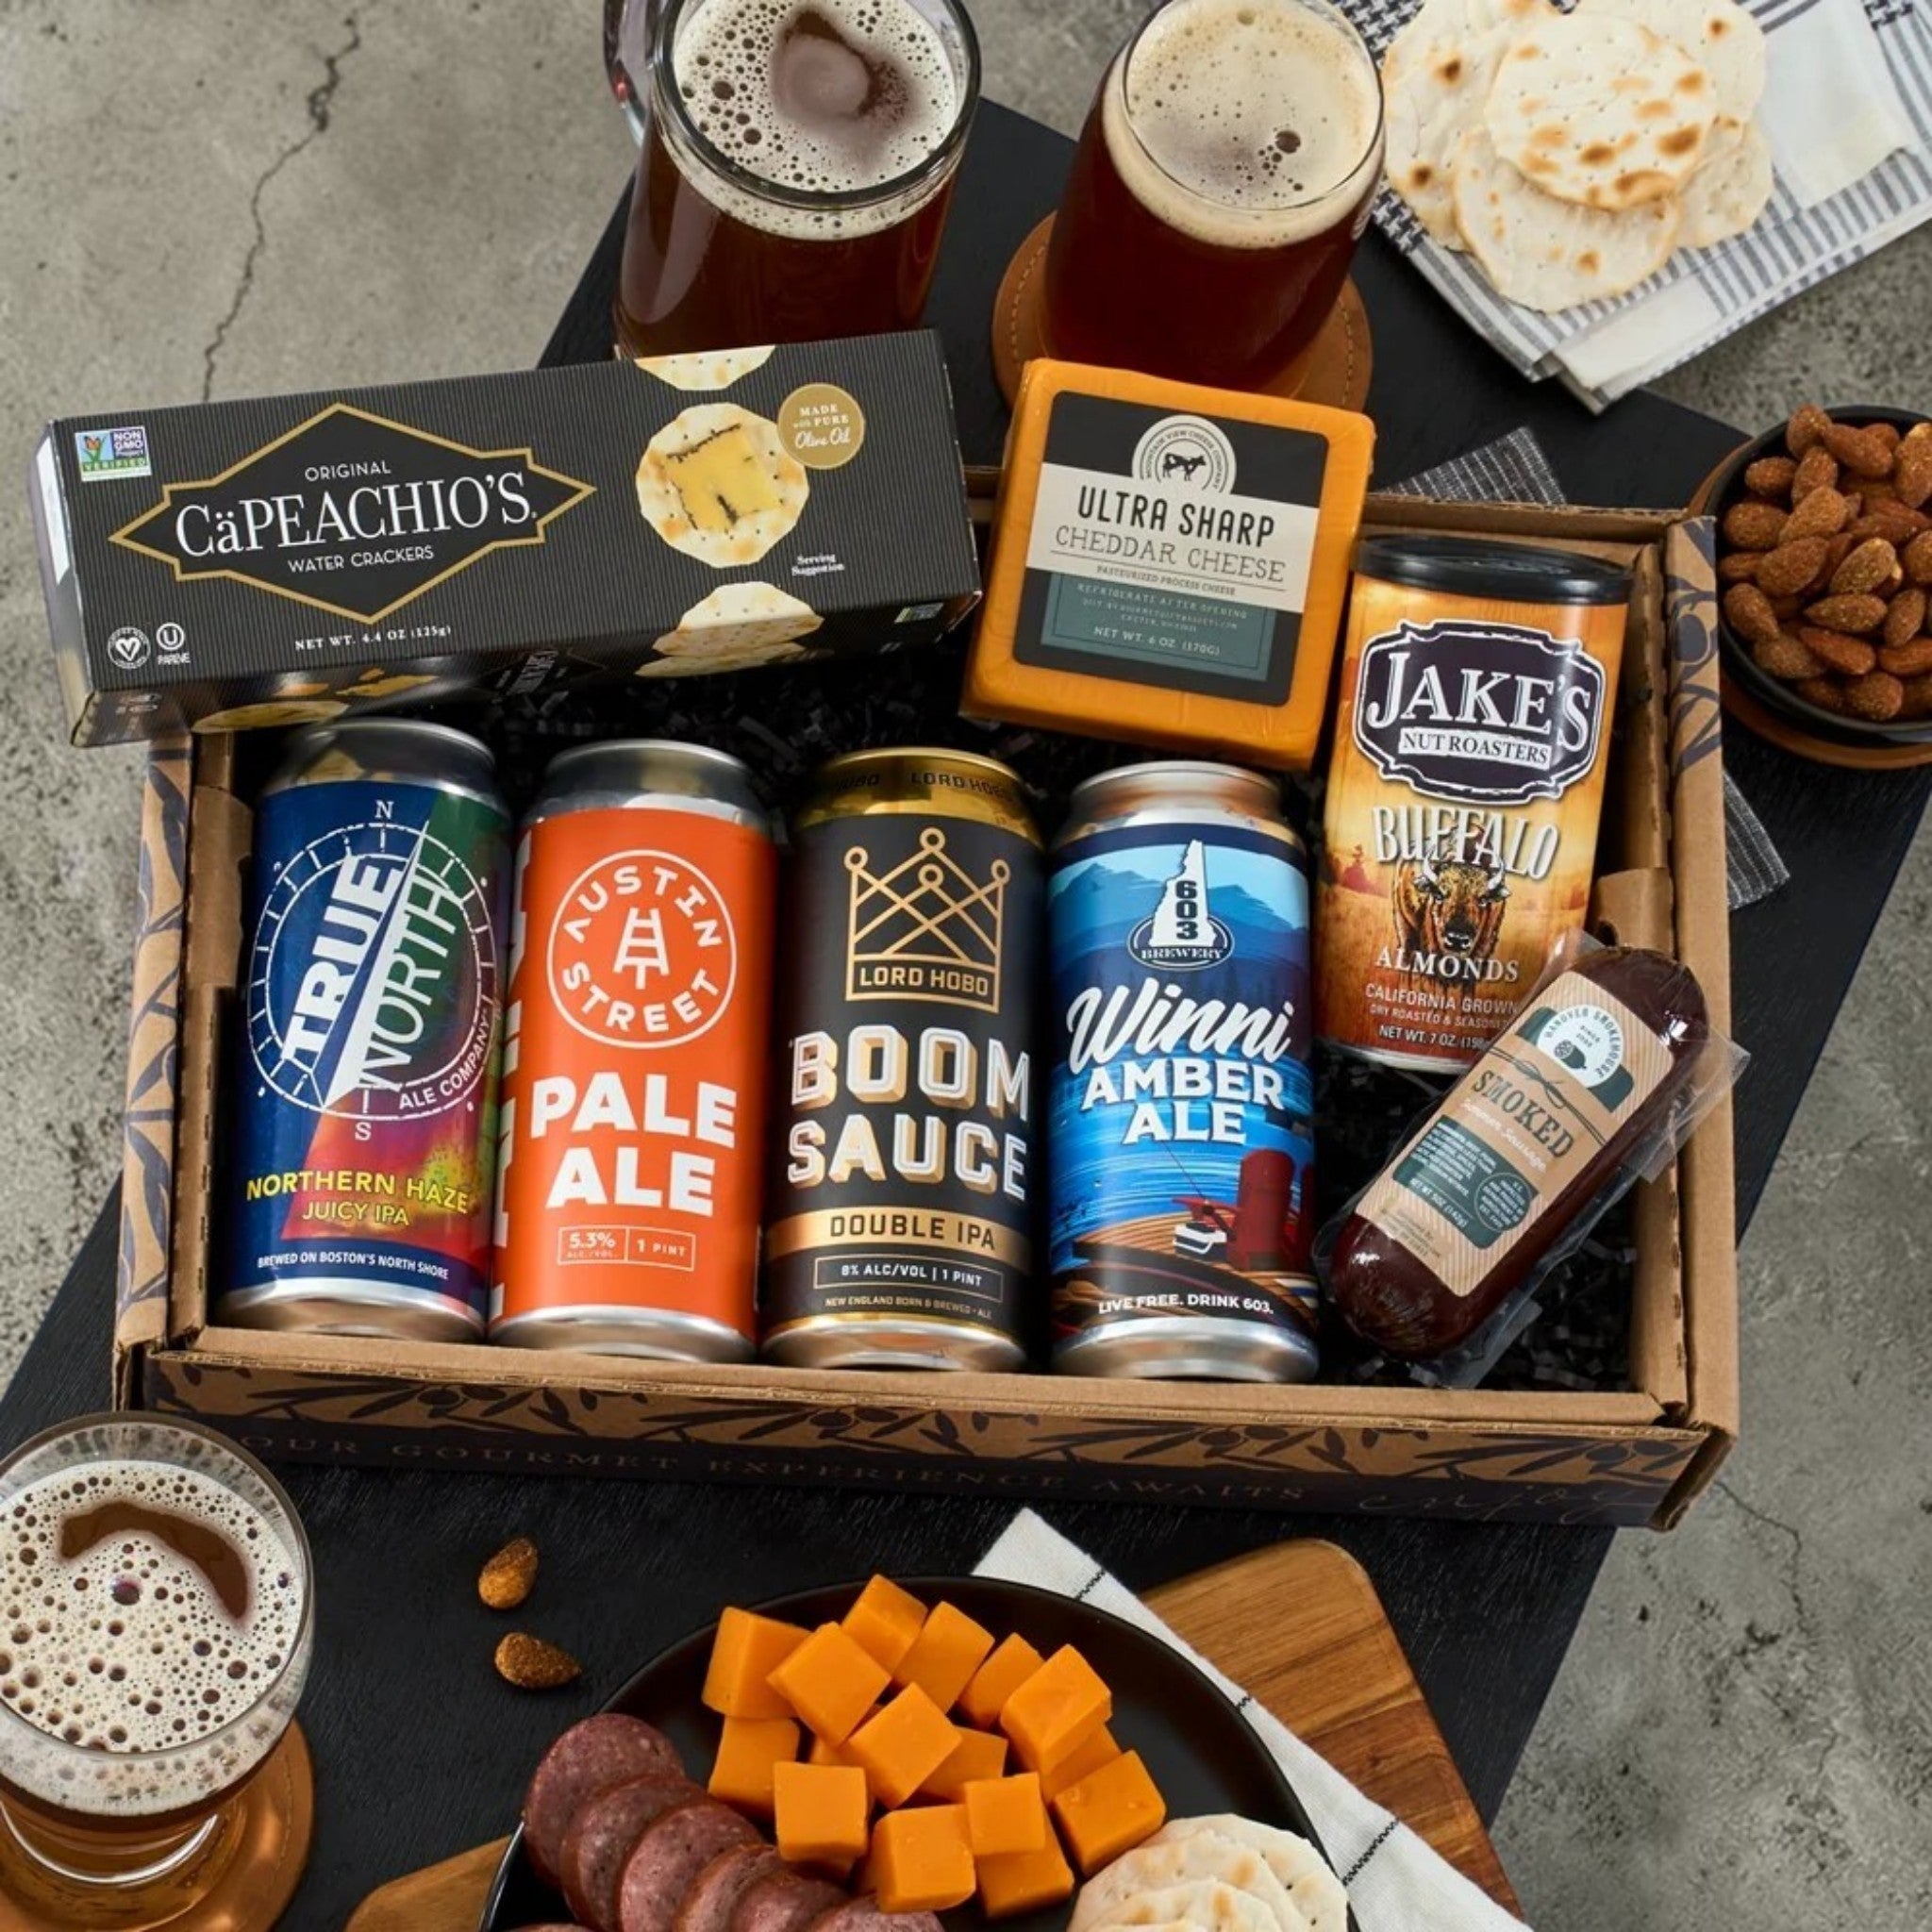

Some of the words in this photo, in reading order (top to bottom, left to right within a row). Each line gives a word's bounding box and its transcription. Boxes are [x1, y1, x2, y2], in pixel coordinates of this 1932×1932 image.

[799, 404, 838, 416] MADE
[813, 415, 849, 426] PURE
[113, 430, 142, 441] NON
[114, 439, 144, 451] GMO
[305, 459, 391, 482] ORIGINAL
[1077, 485, 1169, 532] ULTRA
[1178, 503, 1274, 548] SHARP
[287, 555, 345, 574] WATER
[351, 544, 435, 568] CRACKERS
[1055, 525, 1177, 565] CHEDDAR
[1187, 547, 1287, 583] CHEESE
[1096, 566, 1159, 583] PASTEURIZED
[1160, 575, 1200, 590] PROCESS
[1201, 582, 1236, 595] CHEESE
[294, 637, 325, 652] NET
[330, 634, 357, 647] WT.
[361, 631, 382, 643] 4.4
[387, 628, 407, 641] OZ
[1093, 625, 1119, 640] NET
[1147, 636, 1157, 645] 6
[1158, 636, 1176, 648] OZ
[1366, 652, 1592, 752] JAKE'S
[1404, 732, 1446, 751] NUT
[1449, 736, 1550, 765] ROASTERS
[375, 801, 393, 819] N
[1373, 804, 1559, 880] BUFFALO
[563, 865, 723, 947] AUSTIN
[1175, 880, 1199, 940] 603
[281, 855, 404, 1060] TRUE
[1140, 947, 1224, 960] BREWERY
[1374, 945, 1521, 982] ALMONDS
[364, 868, 462, 1092] NORTH
[859, 966, 923, 987] LORD
[930, 969, 989, 996] HOBO
[562, 961, 719, 1033] STREET
[1365, 982, 1457, 1010] CALIFORNIA
[1462, 997, 1521, 1015] GROWN
[1369, 1003, 1390, 1016] DRY
[1392, 1006, 1441, 1024] ROASTED
[1066, 976, 1295, 1075] Winni
[1378, 1024, 1402, 1039] NET
[1405, 1029, 1426, 1043] WT.
[1429, 1032, 1437, 1044] 7
[399, 1087, 437, 1109] ALE
[440, 1013, 490, 1096] COMPANY
[791, 1024, 1032, 1124] BOOM
[1080, 1058, 1286, 1111] AMBER
[531, 1072, 738, 1150] PALE
[1121, 1100, 1247, 1146] ALE
[1472, 1069, 1574, 1158] SMOKED
[355, 1122, 372, 1141] S
[787, 1113, 1028, 1203] SAUCE
[246, 1169, 396, 1202] NORTHERN
[406, 1177, 470, 1215] HAZE
[545, 1146, 716, 1218] ALE
[301, 1200, 369, 1222] JUICY
[375, 1204, 410, 1226] IPA
[569, 1231, 617, 1250] 5.3%
[637, 1238, 646, 1254] 1
[652, 1242, 687, 1257] PINT
[829, 1214, 946, 1241] DOUBLE
[957, 1221, 996, 1251] IPA
[258, 1252, 299, 1269] BREWED
[299, 1251, 318, 1264] ON
[319, 1251, 376, 1266] BOSTON'S
[377, 1255, 416, 1272] NORTH
[417, 1261, 450, 1281] SHORE
[841, 1264, 859, 1277] 8%
[862, 1263, 928, 1278] ALC/VOL
[952, 1272, 983, 1288] PINT
[824, 1298, 846, 1307] NEW
[847, 1295, 894, 1307] ENGLAND
[895, 1296, 923, 1307] BORN
[1098, 1297, 1132, 1315] LIVE
[1135, 1293, 1185, 1308] FREE.
[1187, 1293, 1240, 1308] DRINK
[1242, 1297, 1274, 1315] 603.
[391, 1442, 679, 1470] GOURMET
[708, 1457, 1066, 1488] EXPERIENCE
[1090, 1478, 1305, 1500] AWAITS
